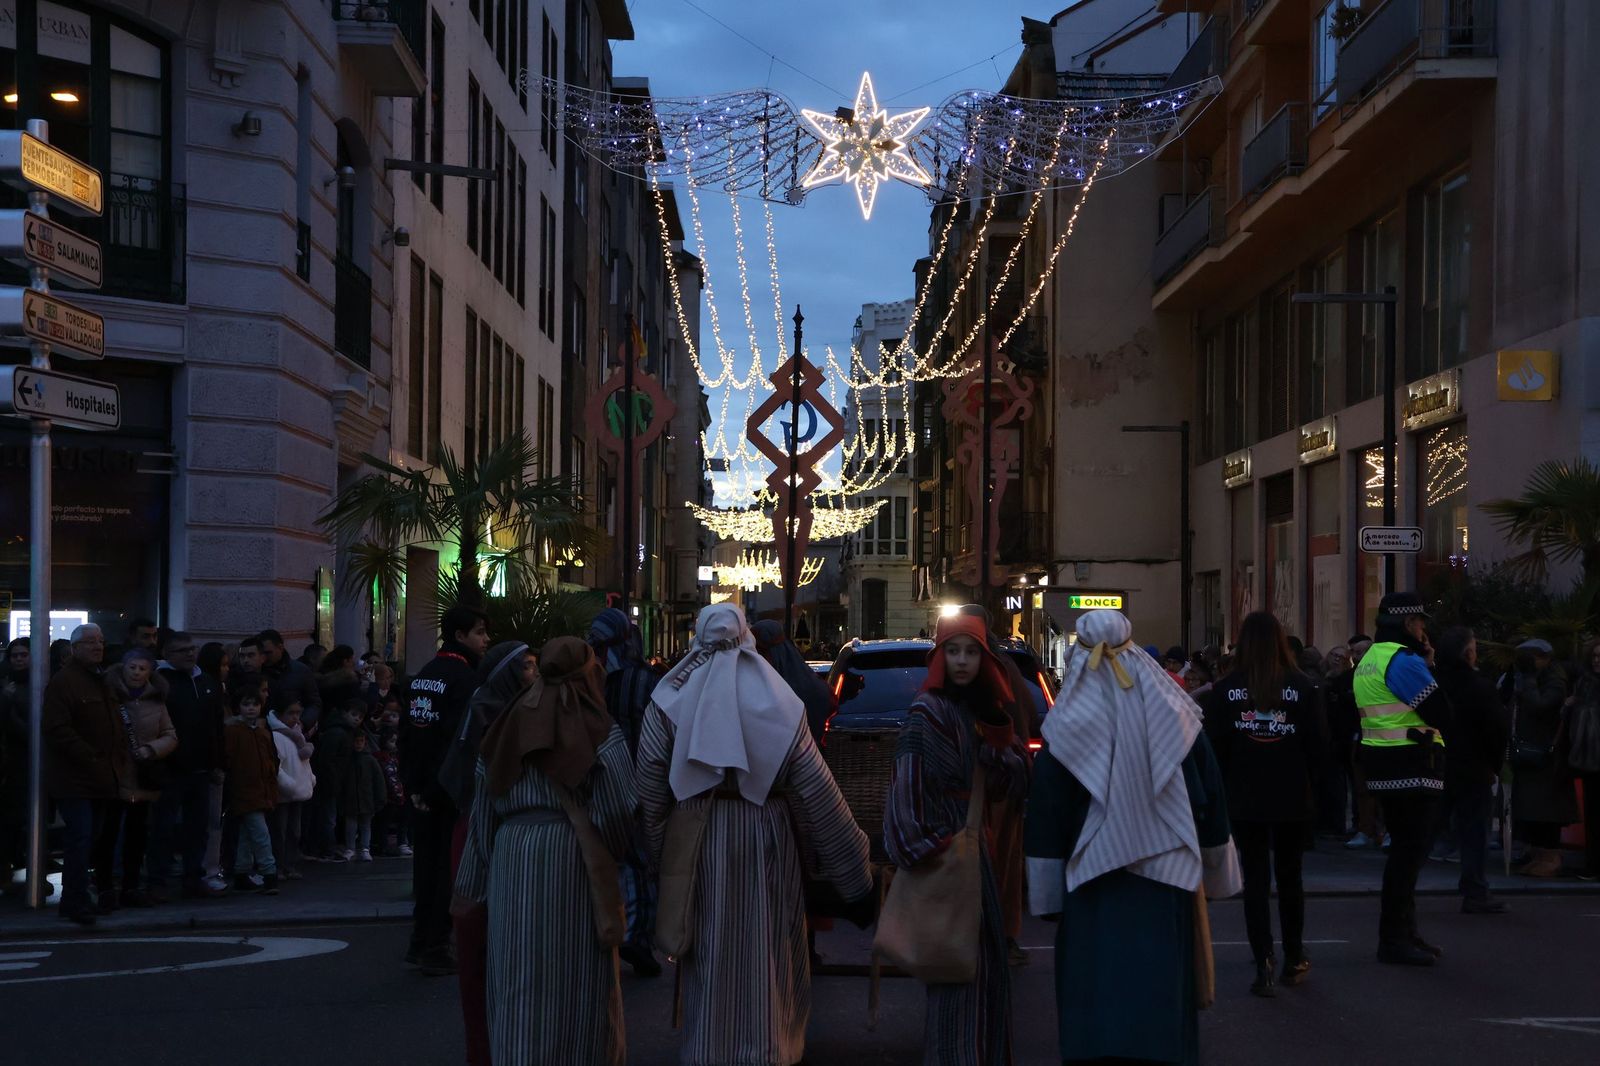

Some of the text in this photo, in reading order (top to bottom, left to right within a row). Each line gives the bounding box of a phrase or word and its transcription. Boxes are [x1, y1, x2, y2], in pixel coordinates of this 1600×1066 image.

[40, 17, 88, 39] URBAN
[23, 139, 72, 178] FUENTESAUCO
[23, 157, 66, 192] FERMOSELLE
[57, 241, 99, 271] SALAMANCA
[65, 311, 101, 334] TORDESILLAS
[65, 328, 101, 350] VALLADOLID
[66, 390, 116, 417] Hospitales
[1084, 598, 1118, 607] ONCE
[1268, 719, 1296, 735] Reyes
